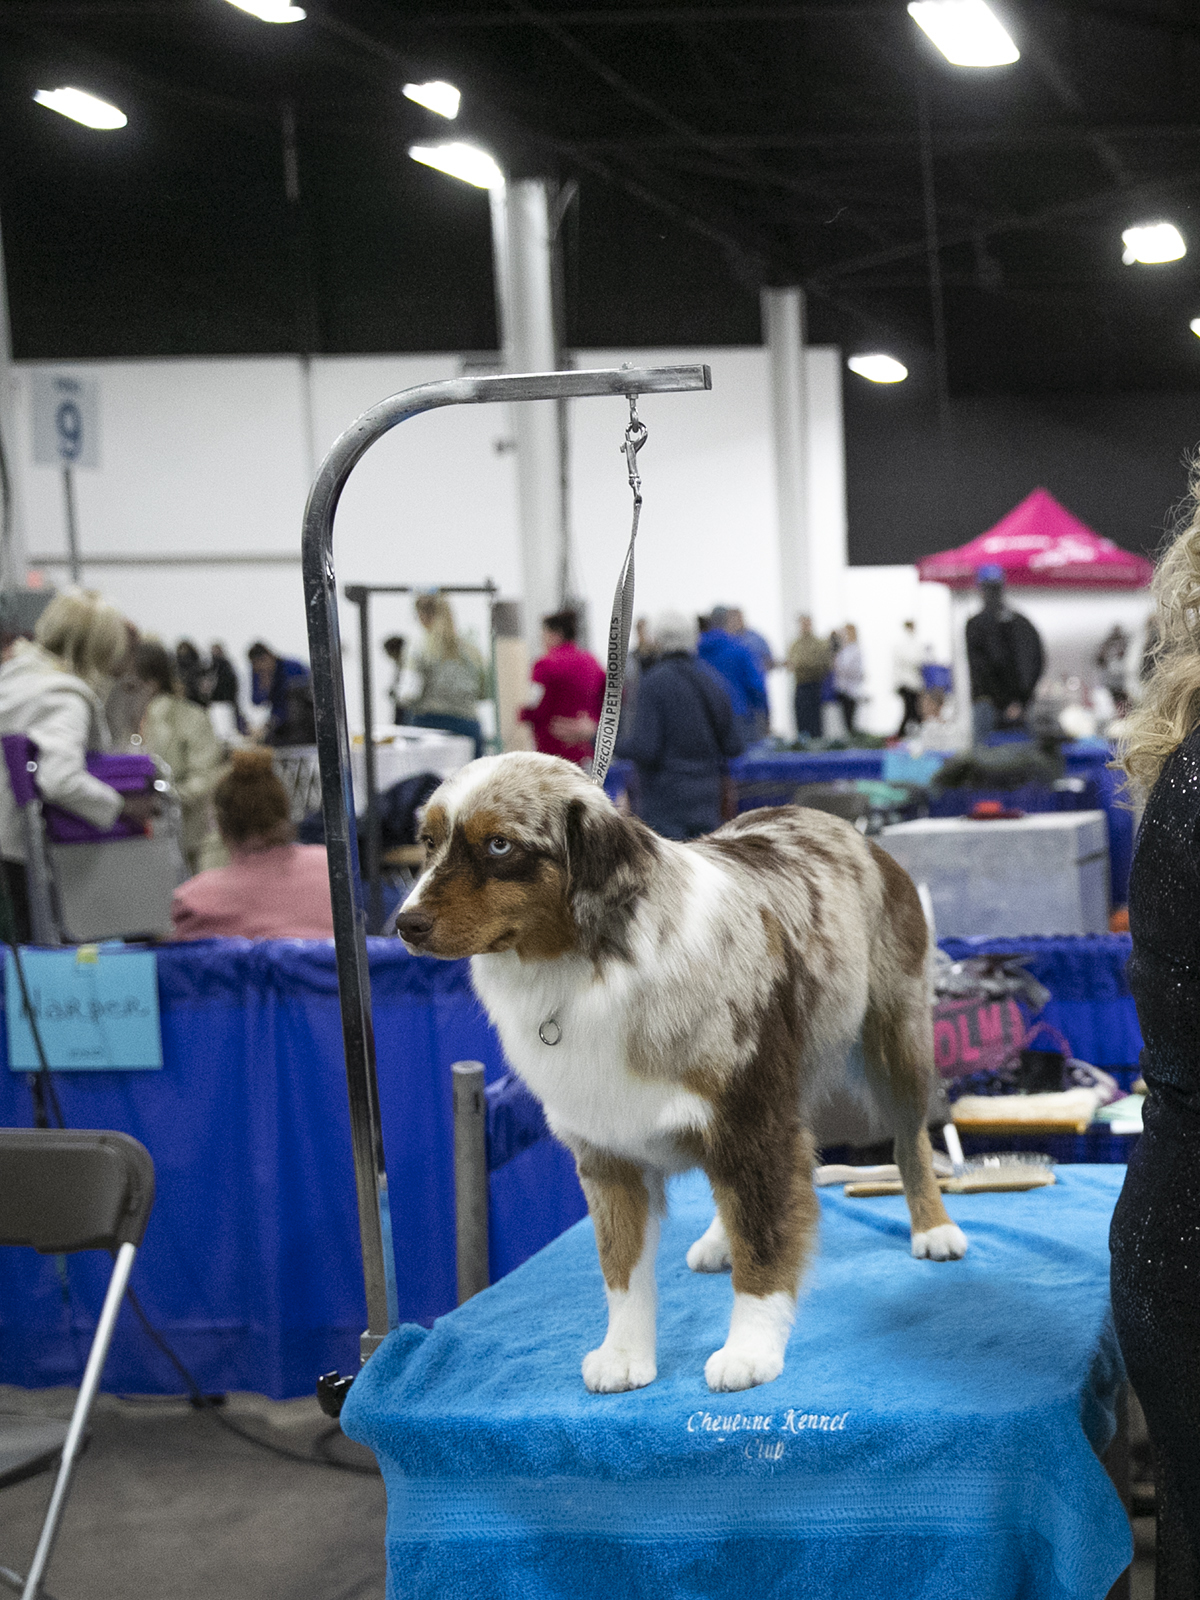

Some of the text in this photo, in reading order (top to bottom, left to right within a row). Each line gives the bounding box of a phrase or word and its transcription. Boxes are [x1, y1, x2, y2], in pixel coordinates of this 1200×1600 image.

[596, 616, 620, 779] PRECISION PET PRODUCTS
[687, 1408, 850, 1442] Cheyenne Kennel
[744, 1438, 785, 1460] Club
